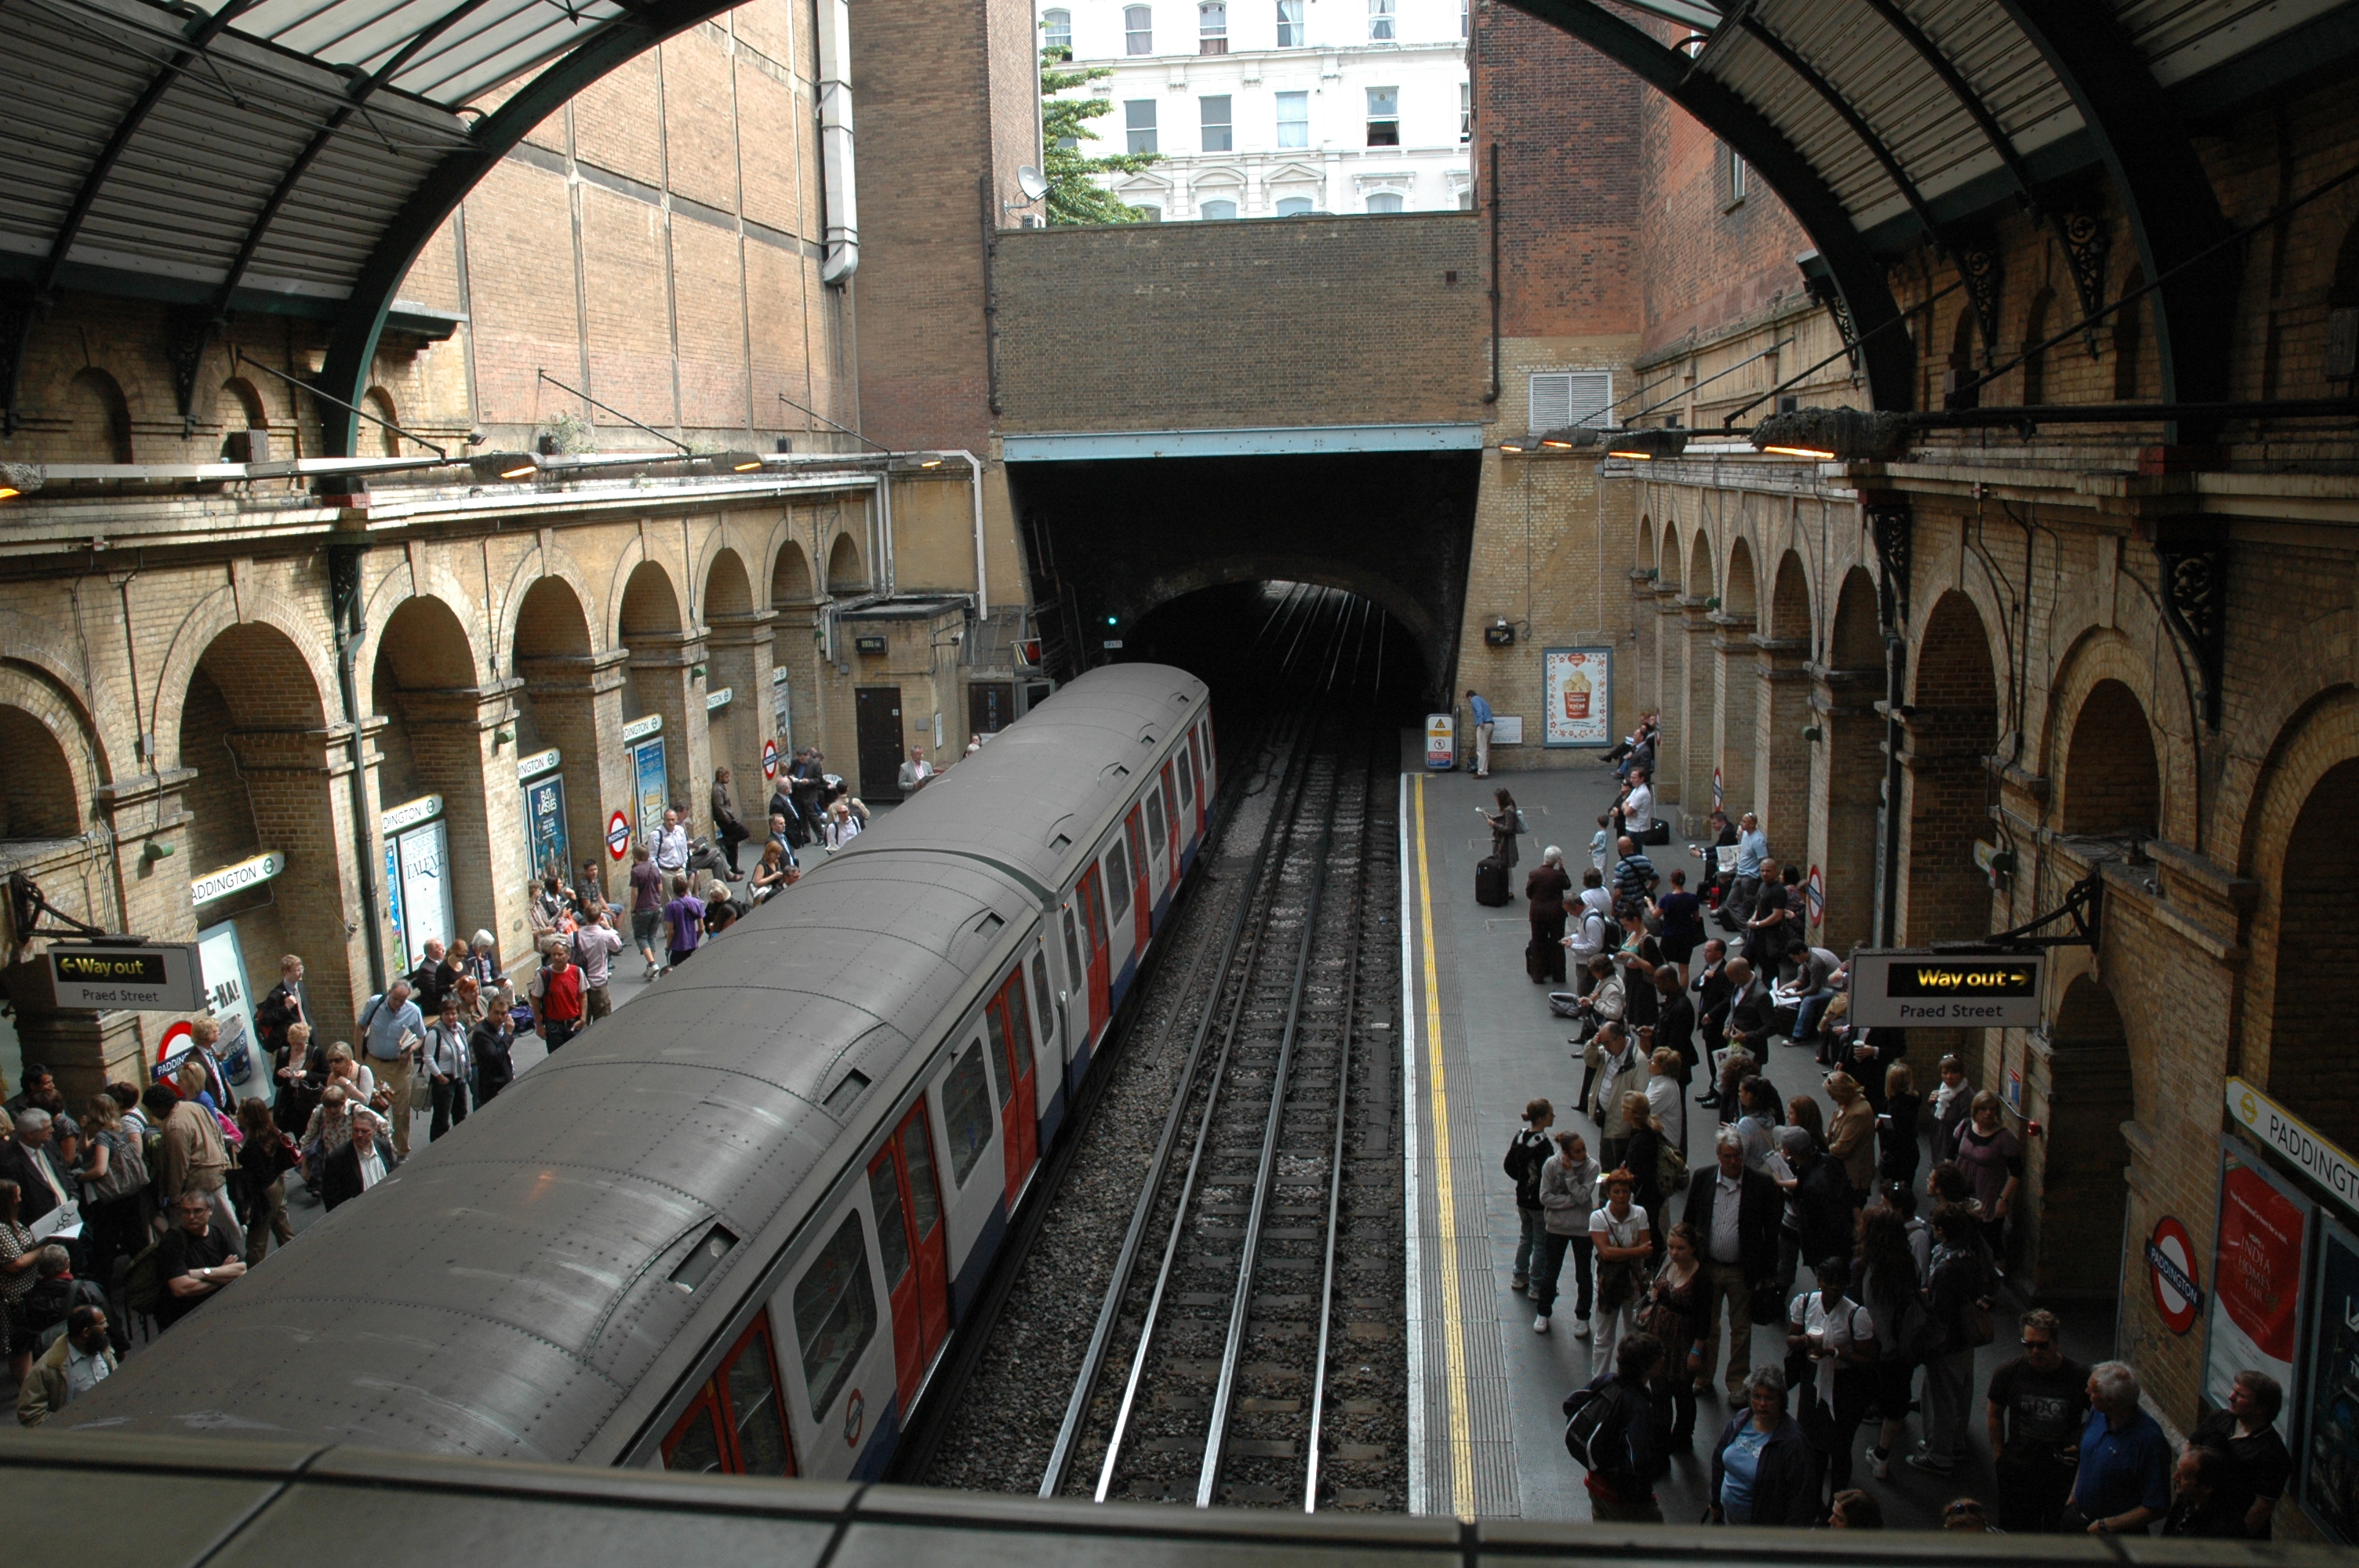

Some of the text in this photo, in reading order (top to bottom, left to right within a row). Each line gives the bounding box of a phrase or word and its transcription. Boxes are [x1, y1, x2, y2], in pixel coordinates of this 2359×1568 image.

[75, 958, 144, 977] Way out
[1917, 969, 2007, 990] Way out
[82, 989, 159, 1002] Praed Street
[1900, 1004, 2003, 1018] Praed Street
[2241, 1236, 2270, 1274] INDIA
[2150, 1247, 2197, 1304] PADDINGTON
[2238, 1256, 2270, 1291] HOMES
[2245, 1281, 2263, 1303] FAIR
